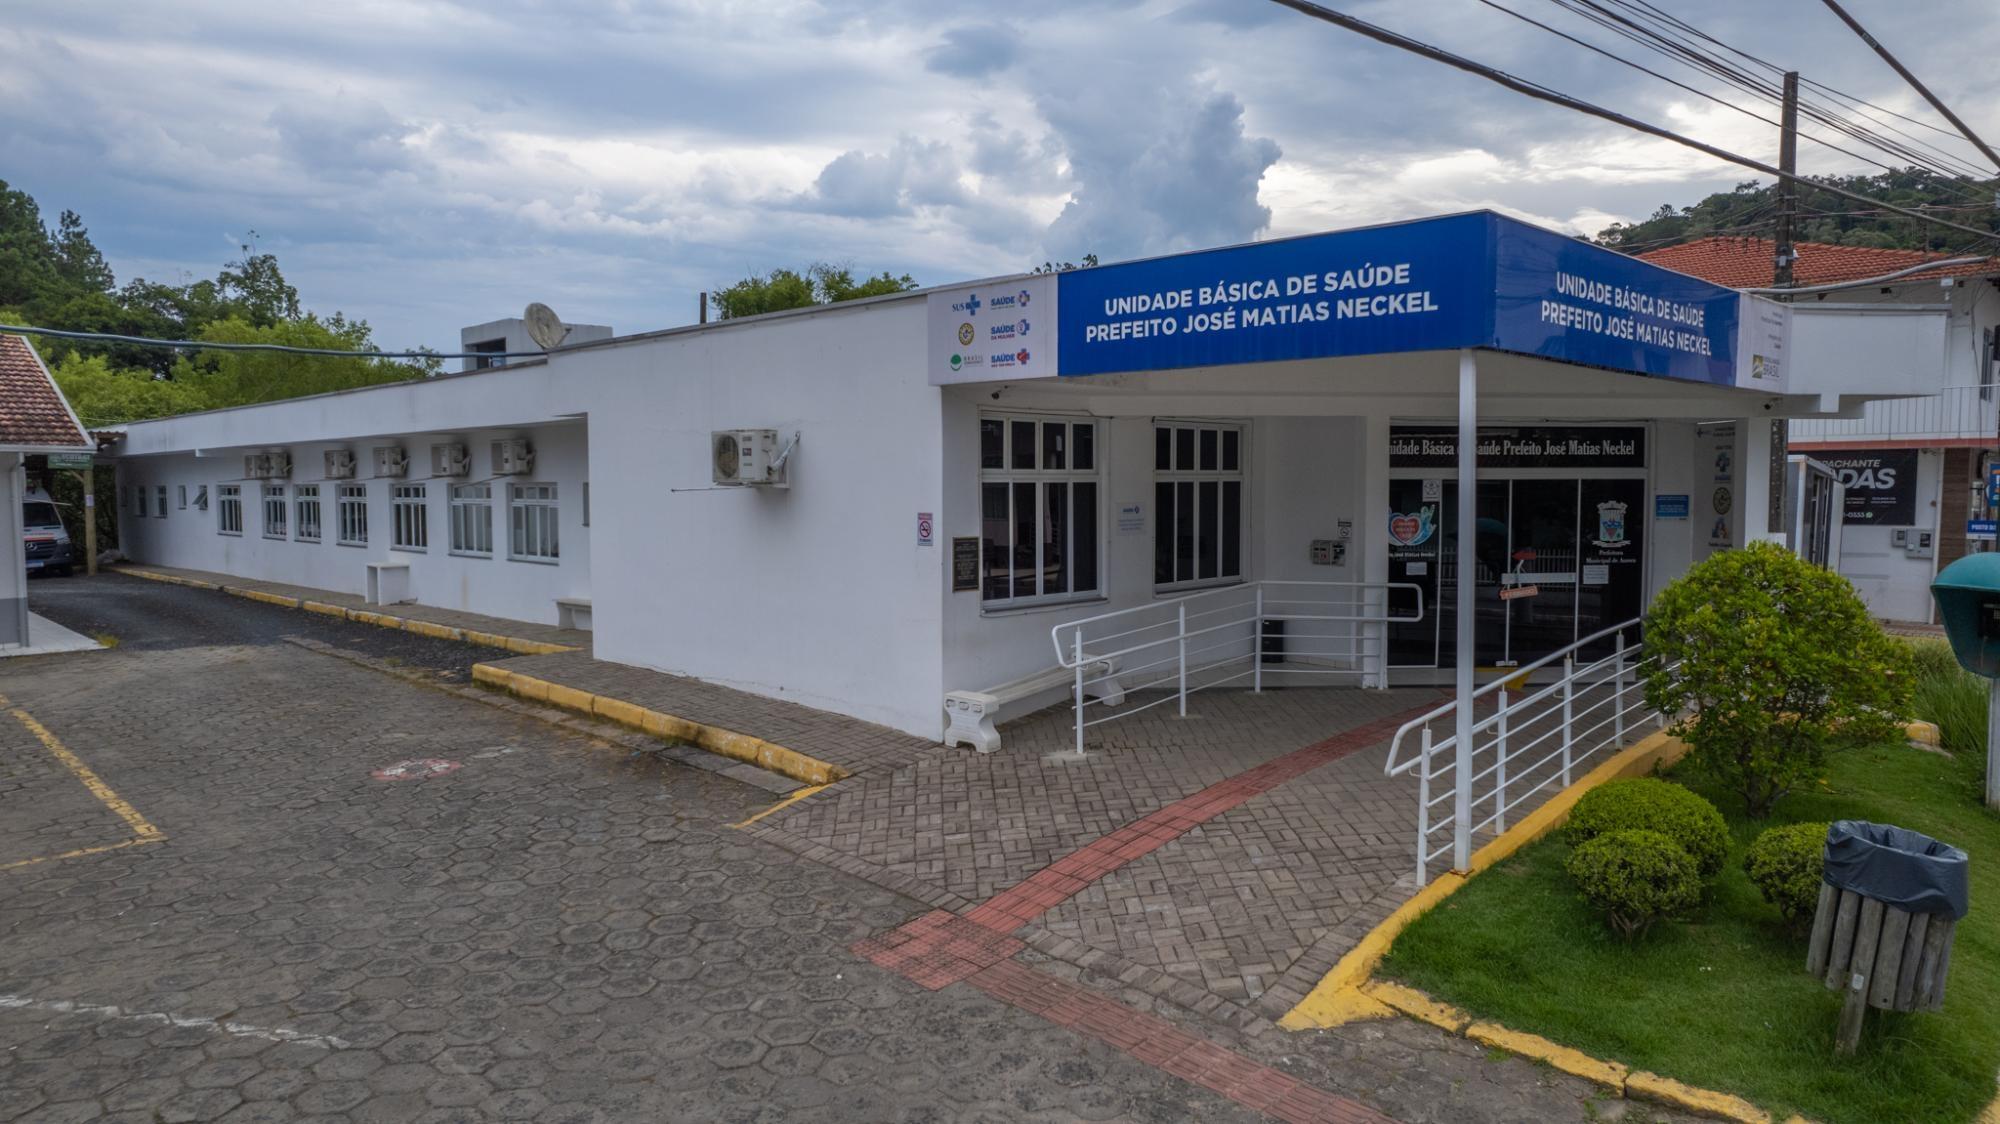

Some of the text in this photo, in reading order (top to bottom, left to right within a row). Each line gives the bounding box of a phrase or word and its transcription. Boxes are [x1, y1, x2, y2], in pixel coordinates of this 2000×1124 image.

[952, 303, 965, 312] SUS
[1105, 262, 1410, 316] UNIDADE BÁSICA DE SAÚDE
[1556, 271, 1704, 328] UNIDADE BÁSICA DE SAÚDE
[991, 324, 1015, 335] SAÚDE
[1085, 291, 1439, 343] PREFEITO JOSÉ MATIAS NECKEL
[1541, 300, 1712, 356] PREFEITO JOSÉ MATIAS NECKEL
[1422, 439, 1454, 456] Básica
[1477, 439, 1501, 456] aúde
[1503, 439, 1542, 456] Prefeito
[1543, 439, 1566, 456] José
[1568, 439, 1601, 456] Matias
[1602, 439, 1635, 456] Neckel
